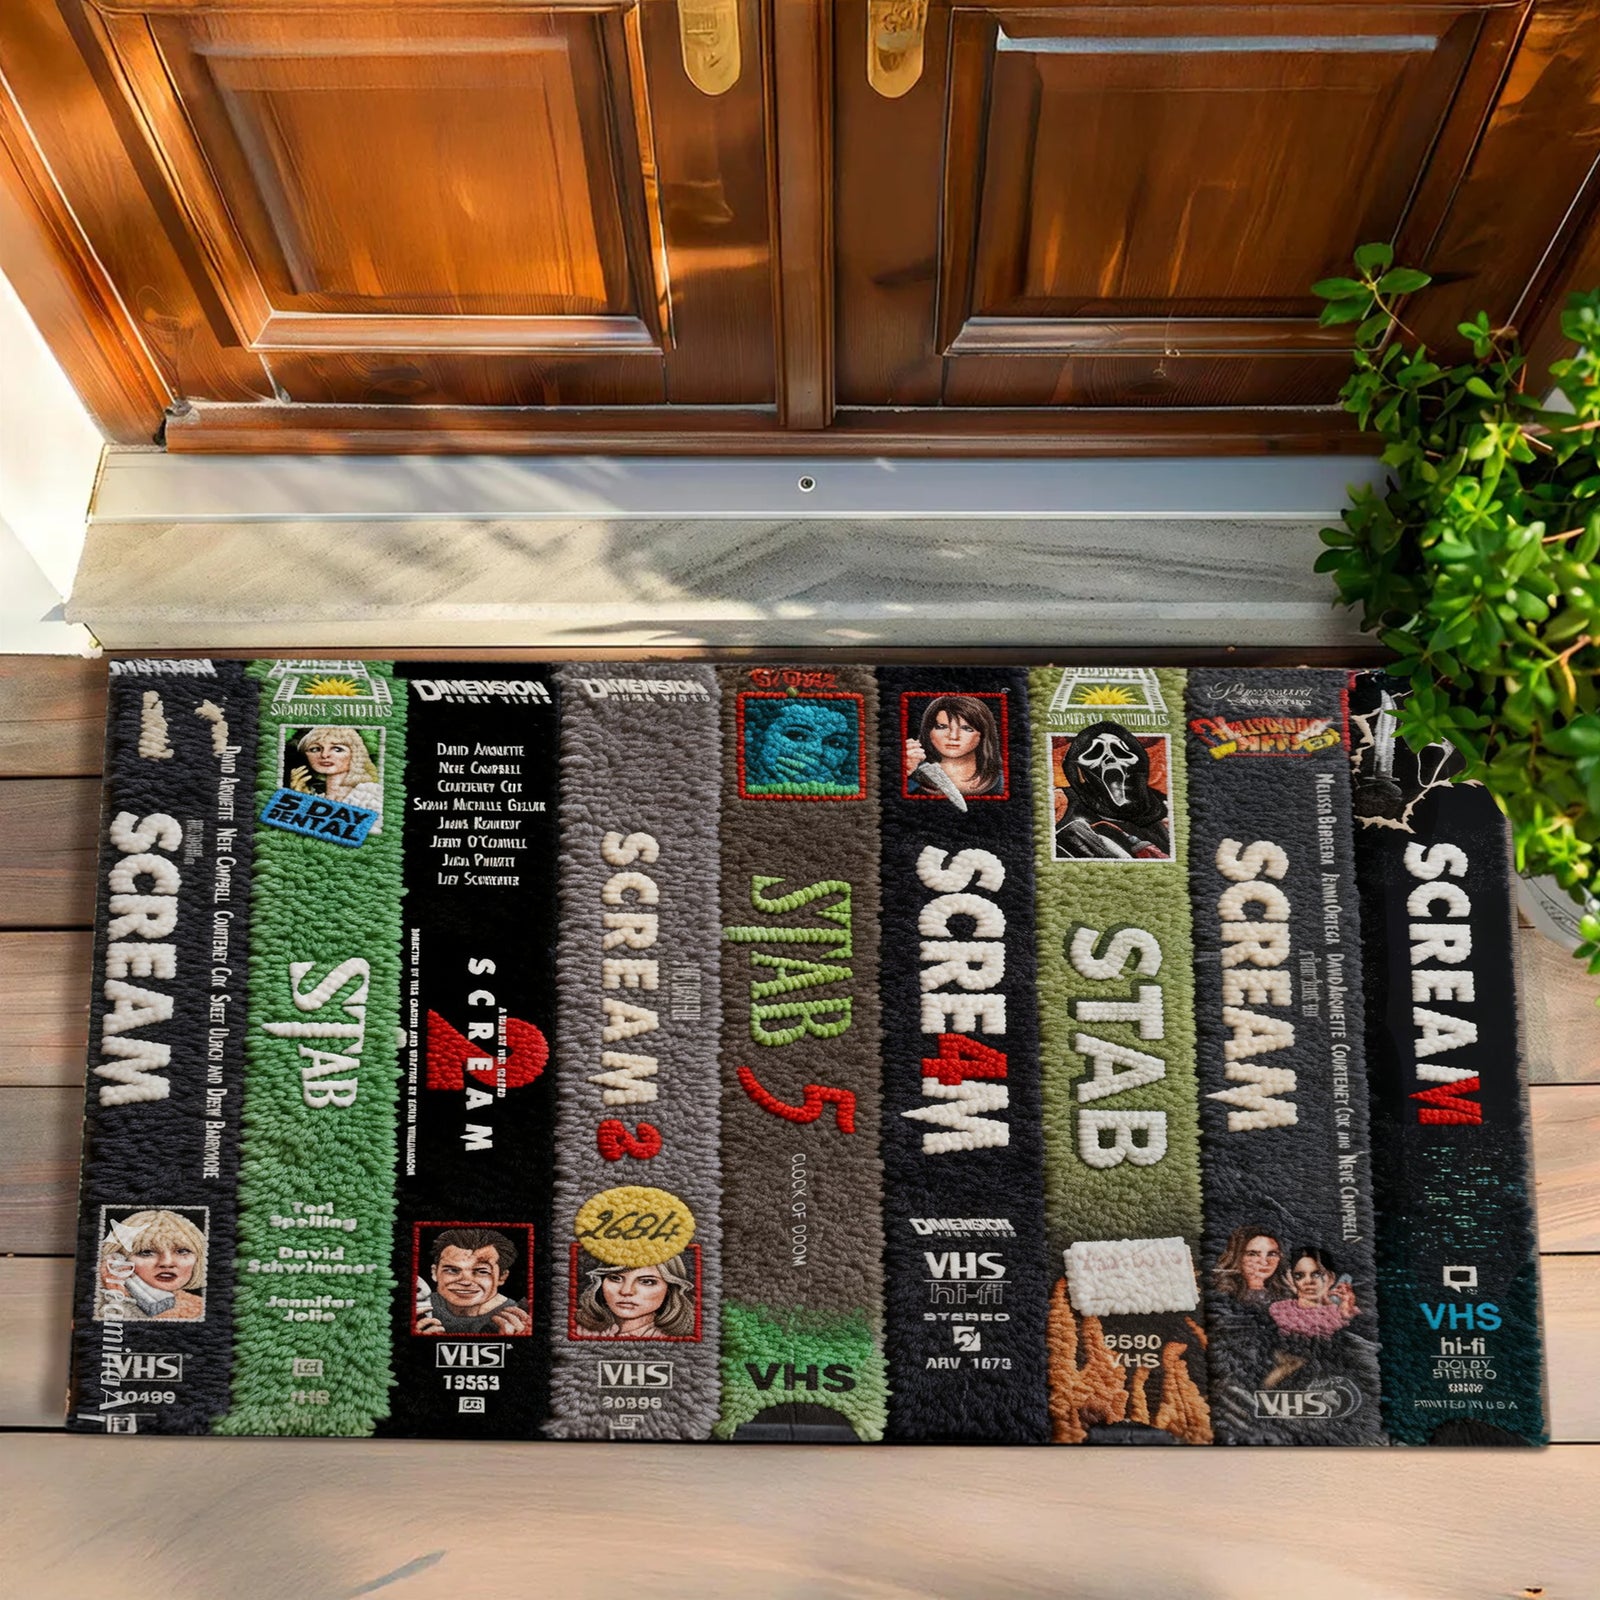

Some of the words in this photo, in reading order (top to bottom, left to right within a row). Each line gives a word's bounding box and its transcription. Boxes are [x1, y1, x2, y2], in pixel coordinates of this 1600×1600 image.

[411, 679, 549, 701] DIMENSION
[571, 678, 708, 699] DIMENSION
[267, 807, 360, 842] RENTAL
[273, 794, 303, 812] 5
[306, 800, 370, 825] DAY
[93, 811, 183, 1107] SCREAM
[587, 831, 660, 1106] SCREAM
[722, 875, 853, 1047] STAB
[901, 845, 1011, 1155] SCRE4M
[1205, 838, 1299, 1132] SCREAM
[1403, 841, 1483, 1126] SCREAM
[261, 957, 371, 1109] STAB
[1069, 927, 1168, 1169] STAB
[460, 957, 497, 1151] SCREAM
[736, 1066, 857, 1133] 5
[792, 1153, 807, 1199] CLOCK
[792, 1202, 807, 1219] OF
[278, 1246, 345, 1260] David
[792, 1224, 807, 1267] DOOM
[923, 1252, 1006, 1279] VHS
[1419, 1302, 1503, 1332] VHS
[440, 1345, 501, 1367] VHS
[1440, 1336, 1486, 1355] hi-fi
[112, 1355, 179, 1379] VHS
[603, 1363, 669, 1386] VHS
[745, 1363, 856, 1393] VHS
[1258, 1392, 1327, 1416] VHS
